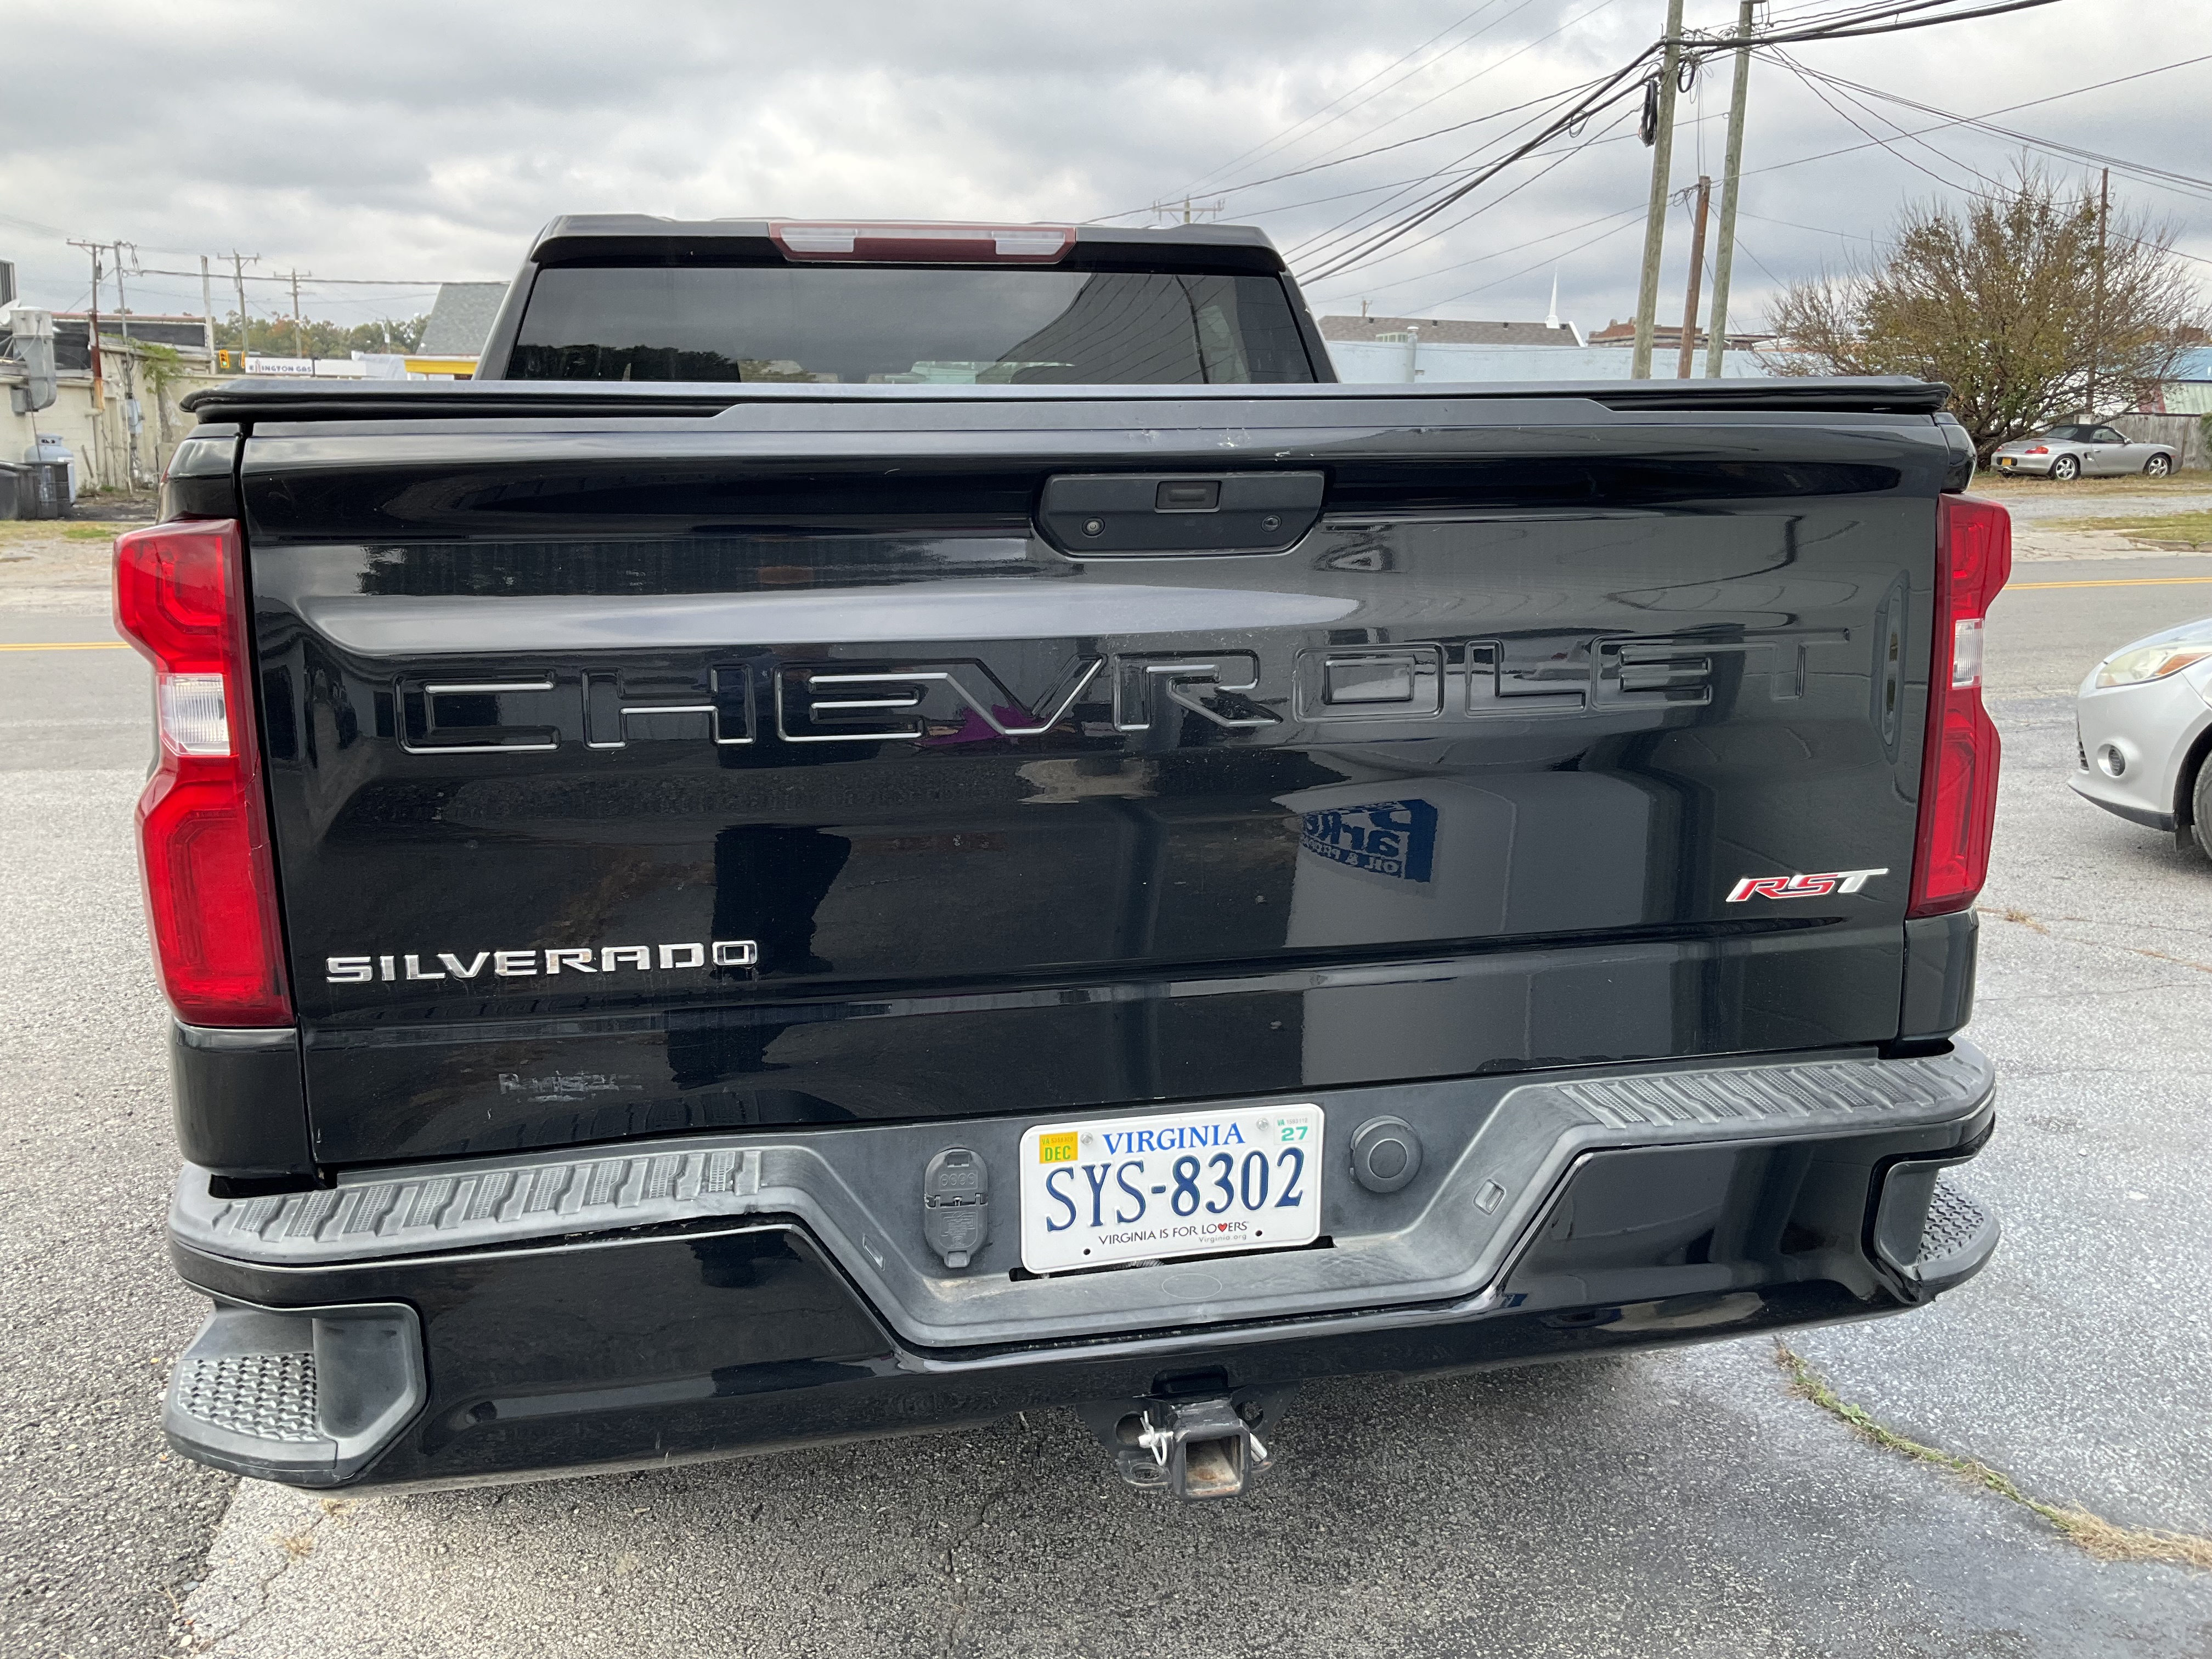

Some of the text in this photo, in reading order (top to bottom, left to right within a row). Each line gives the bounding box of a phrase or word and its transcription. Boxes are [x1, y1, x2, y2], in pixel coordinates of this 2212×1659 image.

[394, 628, 1850, 754] CHEVROLET
[1725, 868, 1889, 902] RST
[326, 940, 758, 983] SILVERADO
[1103, 1122, 1245, 1155] VIRGINIA
[1282, 1126, 1308, 1142] 27
[1045, 1145, 1071, 1161] DEC
[1045, 1146, 1304, 1232] SYS-8302
[1098, 1230, 1156, 1245] VIRGINIA
[1160, 1228, 1169, 1239] IS
[1173, 1226, 1198, 1237] FOR
